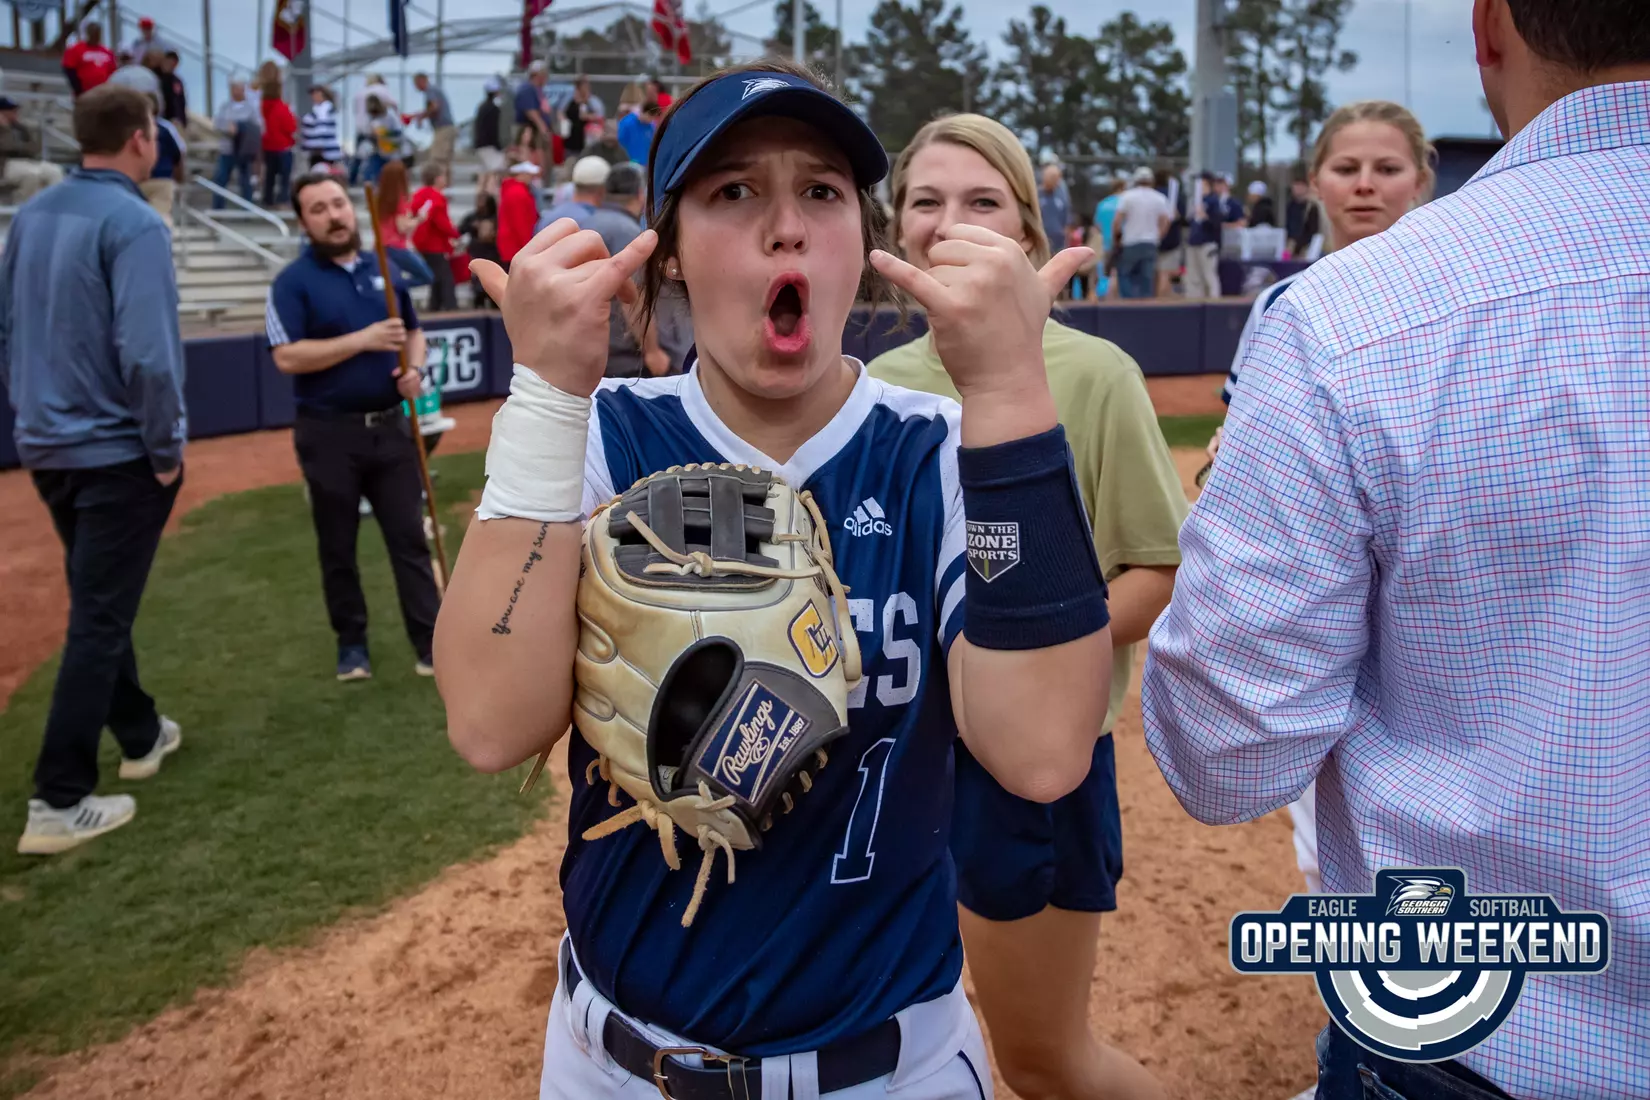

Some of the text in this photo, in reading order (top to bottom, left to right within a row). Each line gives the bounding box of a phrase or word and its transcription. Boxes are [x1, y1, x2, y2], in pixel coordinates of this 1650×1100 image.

[844, 517, 893, 538] adidas
[968, 533, 1017, 549] ZONE
[988, 525, 1016, 534] THE
[968, 547, 1018, 561] SPORTS
[492, 604, 513, 635] You
[510, 577, 525, 604] are
[523, 550, 542, 573] my
[722, 700, 776, 786] Rawlings
[778, 717, 805, 752] Est. 1887
[830, 738, 896, 884] 1
